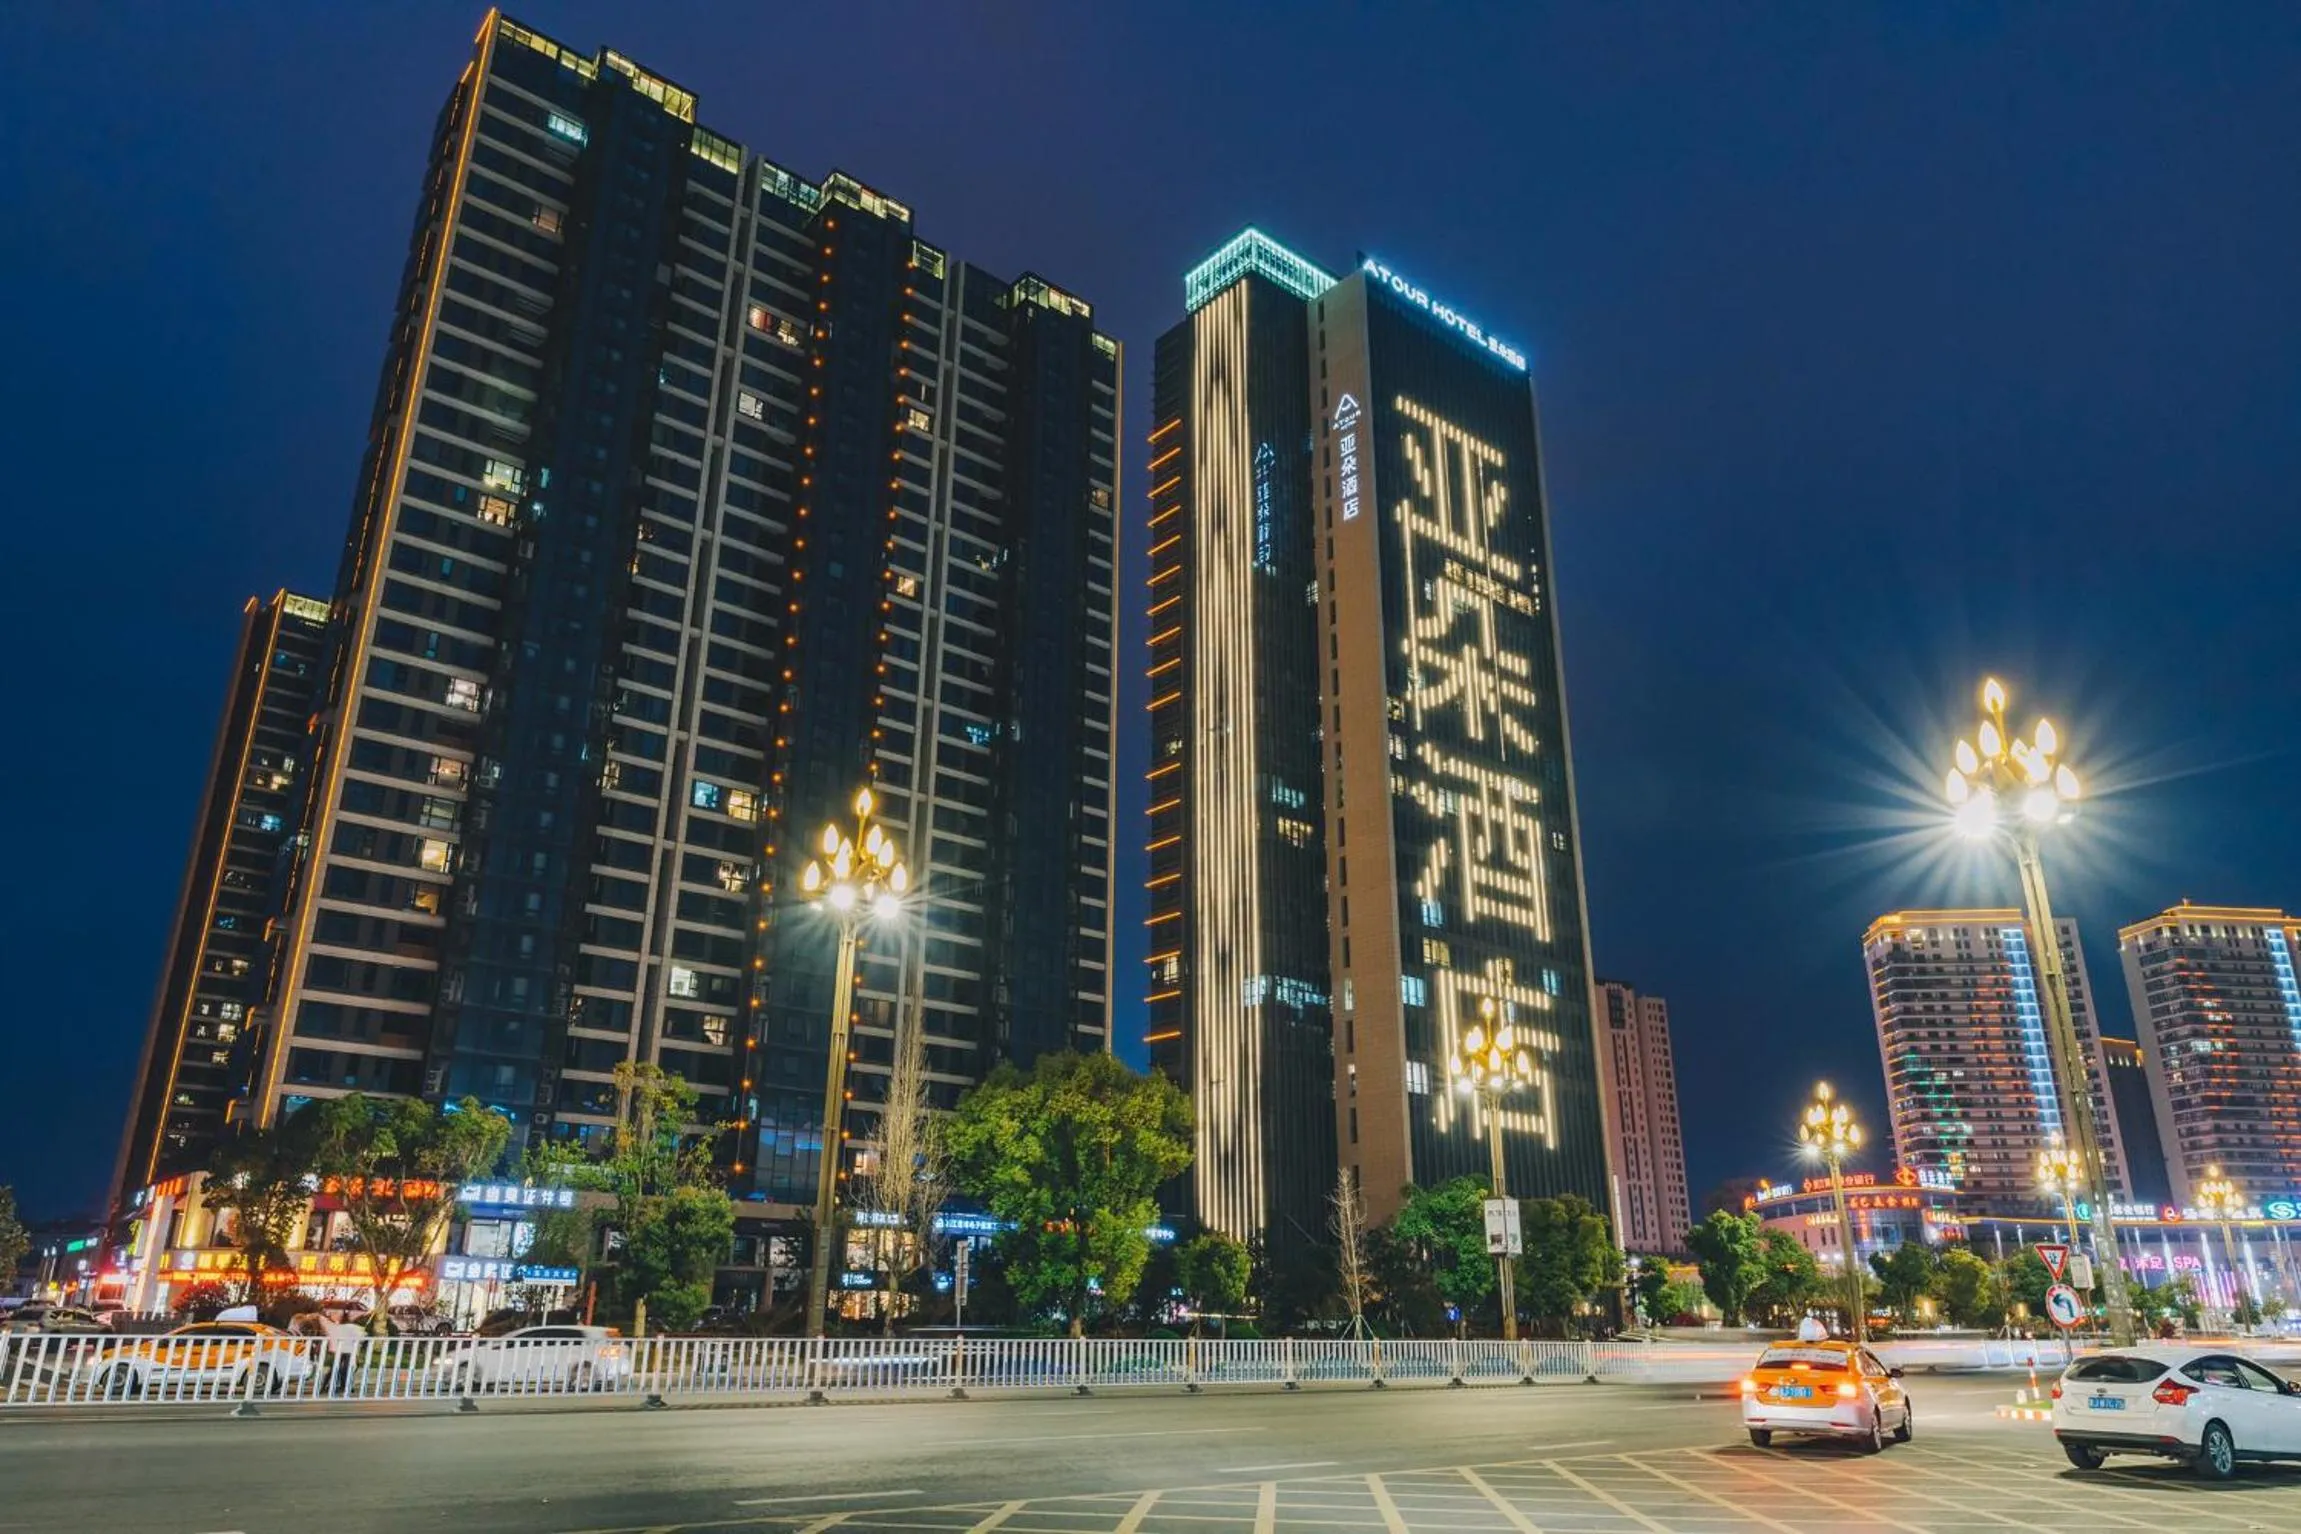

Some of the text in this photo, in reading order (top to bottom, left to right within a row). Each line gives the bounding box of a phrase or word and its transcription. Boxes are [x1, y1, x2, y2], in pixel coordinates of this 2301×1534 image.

[1363, 258, 1487, 347] ATOUR HOTEL
[1340, 433, 1360, 521] 亚朵酒店
[1395, 394, 1560, 1150] 亚朵酒店
[2048, 1252, 2058, 1265] 让
[2173, 1255, 2202, 1270] SPA
